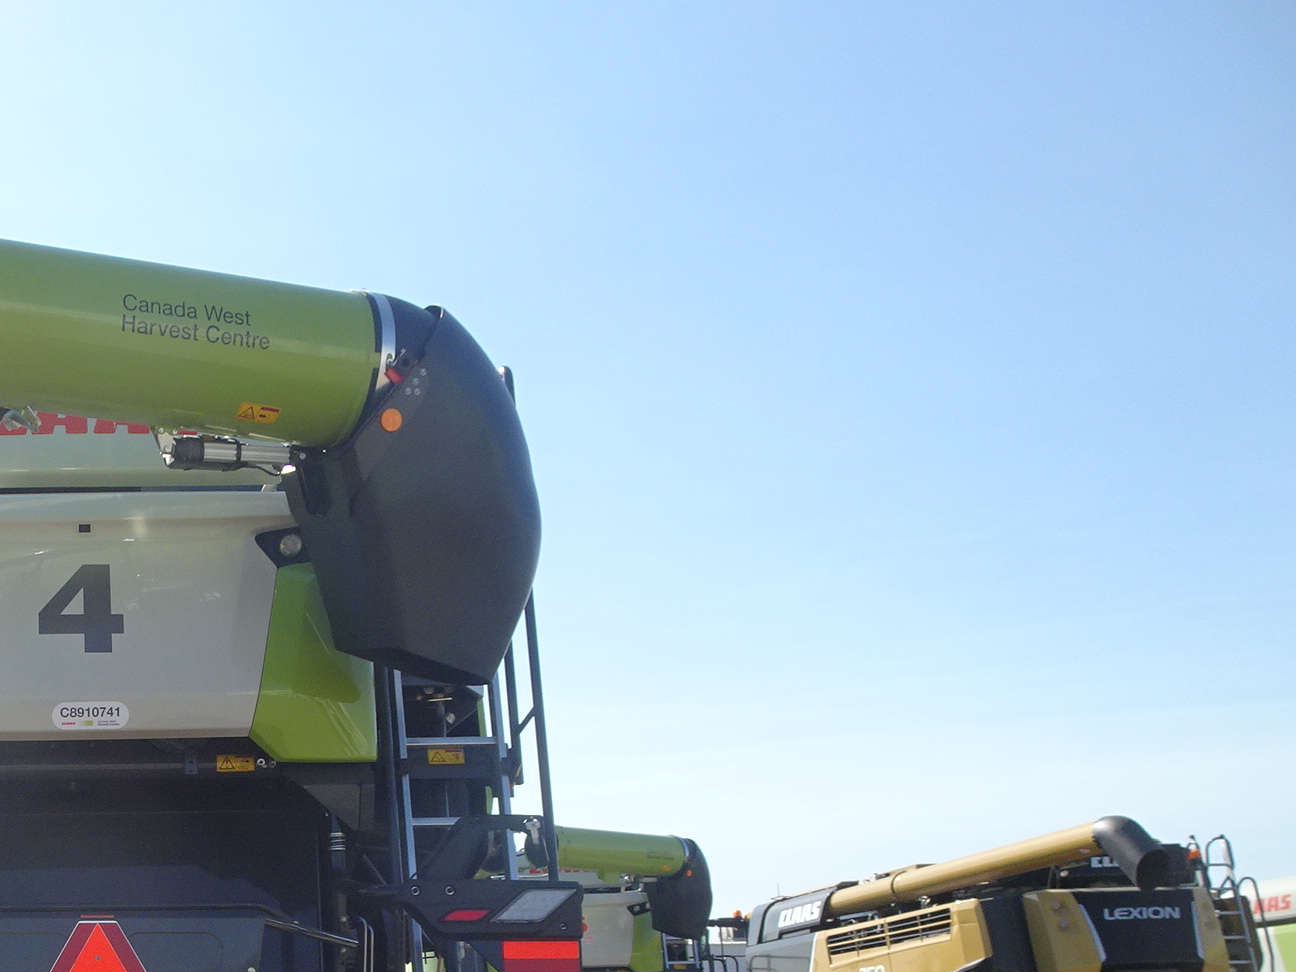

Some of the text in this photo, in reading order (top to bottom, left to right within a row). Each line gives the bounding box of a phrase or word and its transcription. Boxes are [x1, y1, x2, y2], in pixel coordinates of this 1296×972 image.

[122, 293, 252, 327] Canada West
[121, 313, 271, 351] Harvest Centre
[38, 564, 124, 653] 4
[60, 706, 121, 718] C8910741
[777, 900, 822, 928] CLAAS
[1104, 906, 1181, 920] LEXION
